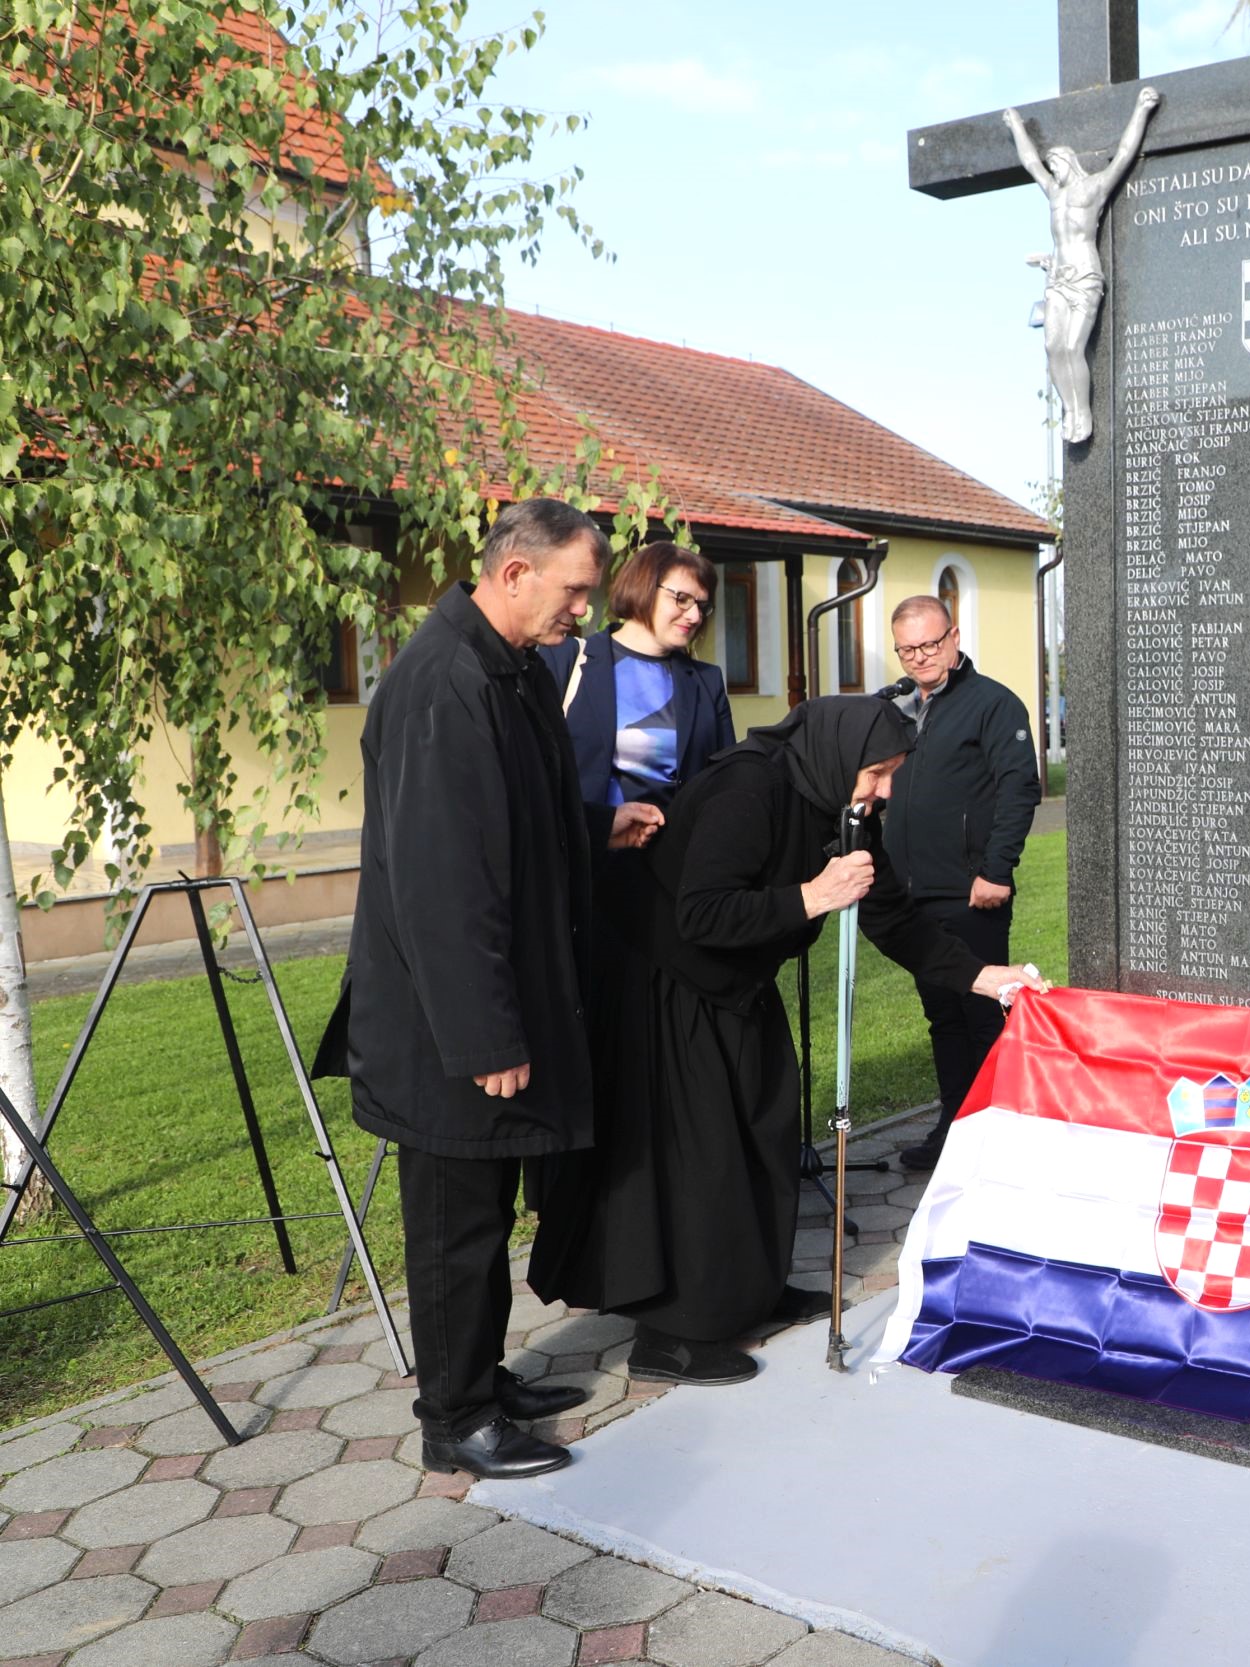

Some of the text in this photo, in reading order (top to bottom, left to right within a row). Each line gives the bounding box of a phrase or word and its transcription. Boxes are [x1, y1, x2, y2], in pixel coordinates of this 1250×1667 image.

[1126, 172, 1198, 198] NESTALI
[1202, 168, 1224, 187] SU
[1133, 206, 1167, 227] ONI
[1173, 199, 1209, 221] ŠTO
[1217, 195, 1239, 214] SU
[1179, 230, 1208, 248] ALI
[1124, 312, 1232, 336] ABRAMOVIĆ MIJO
[1125, 327, 1222, 349] ALABER FRANJO
[1125, 341, 1216, 362] ALABER JAKOV
[1125, 357, 1205, 375] ALABER MIKA
[1125, 370, 1204, 388] ALABER MIJO
[1125, 380, 1227, 402] ALABER STJEPAN
[1125, 395, 1227, 415] ALABER STJEPAN
[1197, 406, 1249, 422] STJEPAN
[1198, 436, 1231, 449] JOSIP
[1126, 453, 1200, 468] BURIĆ ROK
[1126, 465, 1226, 483] BRZIĆ FRANJO
[1126, 480, 1215, 496] BRZIĆ TOMO
[1126, 495, 1211, 510] BRZIĆ JOSIP
[1126, 508, 1208, 523] BRZIĆ MIJO
[1126, 520, 1230, 537] BRZIĆ STJEPAN
[1126, 537, 1208, 551] BRZIĆ MIJO
[1186, 551, 1222, 563] MATO
[1181, 565, 1216, 577] PAVO
[1199, 580, 1231, 591] IVAN
[1199, 593, 1244, 605] ANTUN
[1127, 609, 1177, 621] FABIJAN
[1127, 622, 1243, 636] GALOVIĆ FABIJAN
[1127, 635, 1229, 649] GALOVIĆ PETAR
[1128, 649, 1226, 663] GALOVIĆ PAVO
[1128, 664, 1225, 677] GALOVIĆ JOSIP
[1128, 678, 1225, 691] GALOVIĆ JOSIP
[1128, 691, 1236, 704] GALOVIĆ ANTUN
[1205, 707, 1236, 718] IVAN
[1205, 722, 1240, 733] MARA
[1202, 751, 1246, 762] ANTUN
[1128, 762, 1216, 774] HODAK IVAN
[1201, 778, 1233, 788] JOSIP
[1192, 804, 1244, 816] STJEPAN
[1204, 831, 1238, 843] KATA
[1207, 845, 1250, 857] ANTUN
[1206, 858, 1240, 870] JOSIP
[1207, 873, 1250, 885] ANTUN
[1191, 885, 1238, 898] FRANJO
[1191, 899, 1242, 911] STJEPAN
[1177, 911, 1228, 924] STJEPAN
[1181, 924, 1217, 936] MATO
[1181, 937, 1217, 949] MATO
[1181, 951, 1224, 964] ANTUN
[1181, 965, 1228, 979] MARTIN
